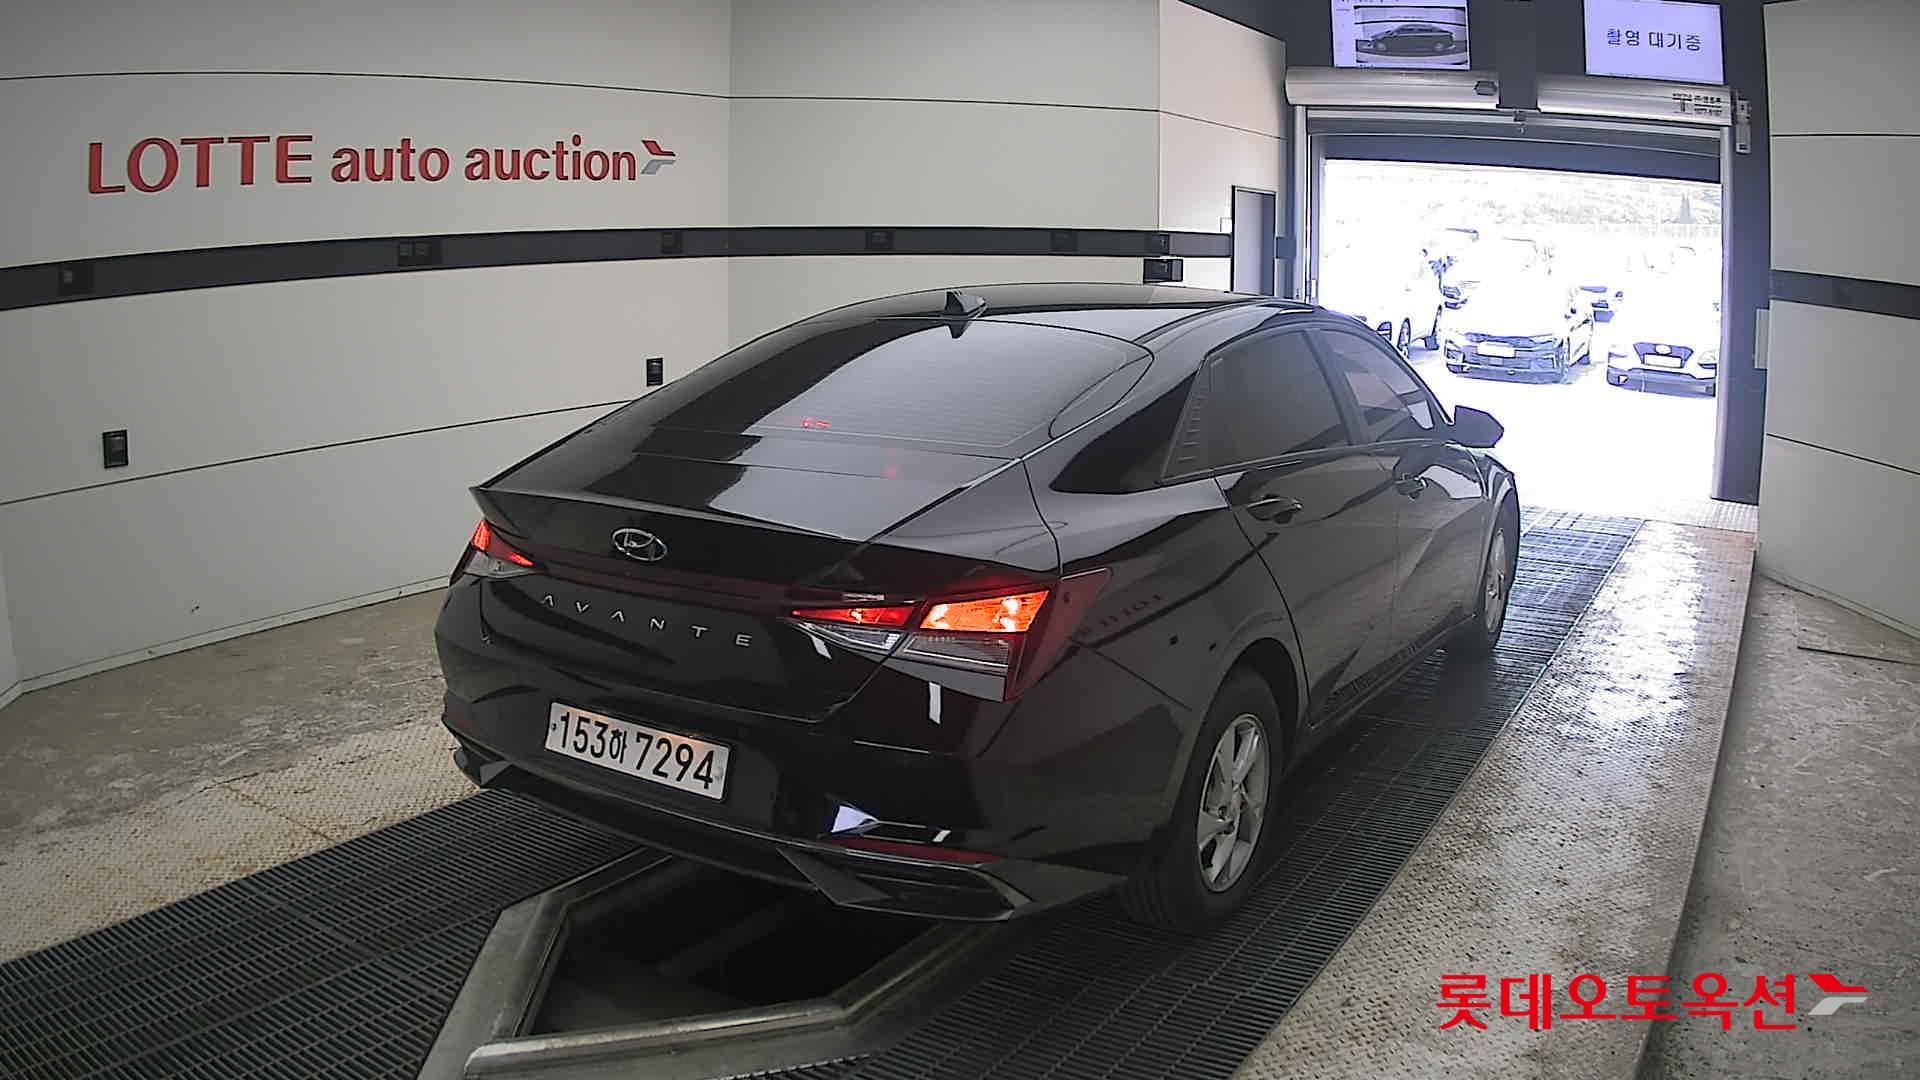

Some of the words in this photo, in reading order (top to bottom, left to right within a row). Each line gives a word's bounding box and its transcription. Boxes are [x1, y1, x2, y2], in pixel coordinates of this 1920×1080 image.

[1648, 31, 1701, 52] 대기중
[87, 134, 314, 194] LOTTE
[330, 137, 450, 184] auto
[464, 133, 637, 182] auction
[541, 593, 754, 647] AVANTE
